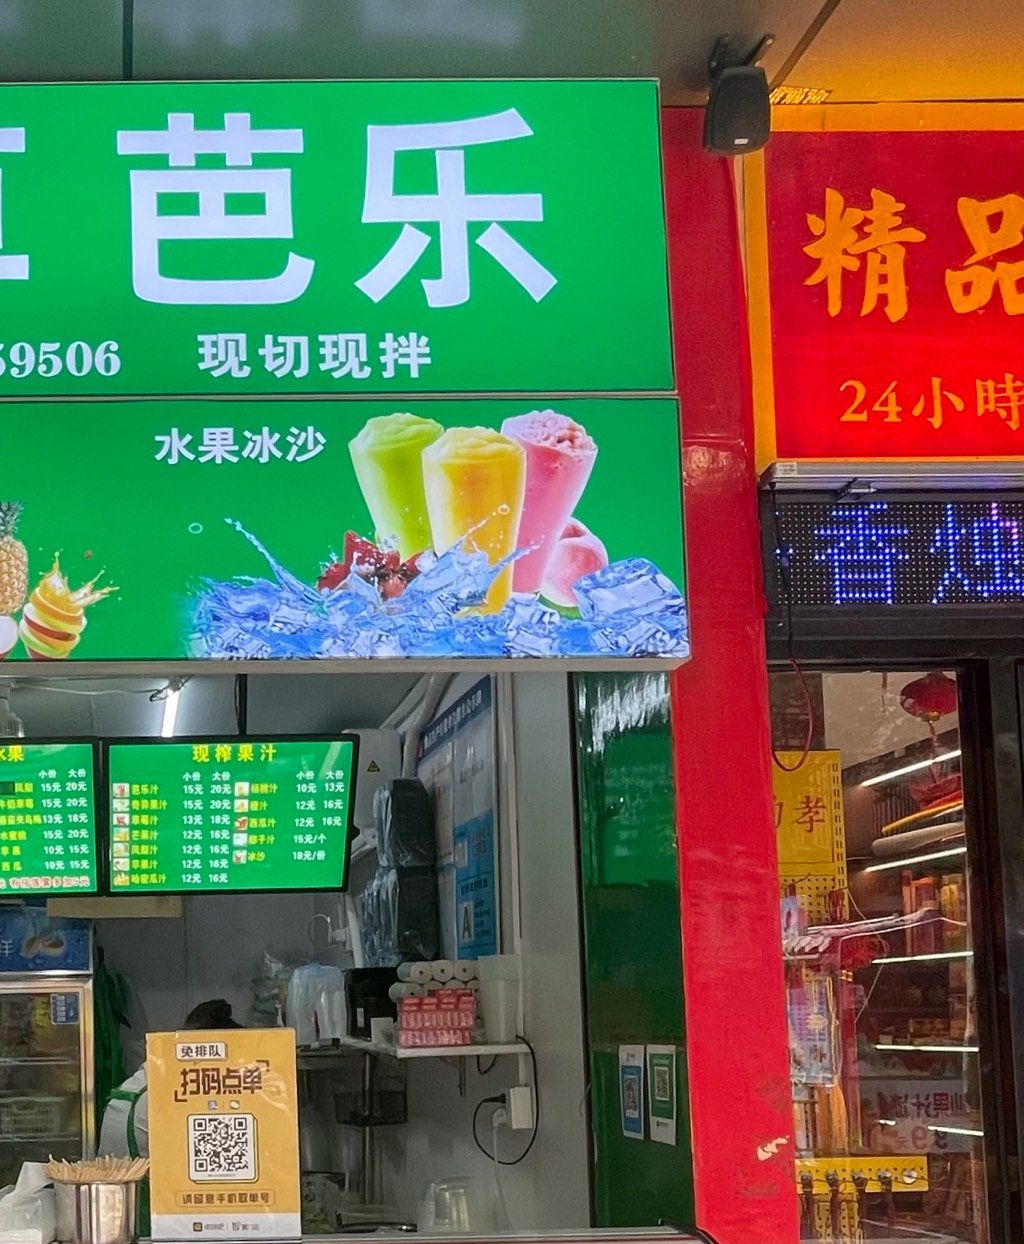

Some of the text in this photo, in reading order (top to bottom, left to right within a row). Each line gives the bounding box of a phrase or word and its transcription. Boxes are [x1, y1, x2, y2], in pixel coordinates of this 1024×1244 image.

[803, 188, 1024, 322] 精品
[198, 332, 431, 378] 现切现拌
[155, 426, 326, 464] 水果冰沙
[193, 744, 277, 762] 现榨果汁
[39, 768, 86, 779] 小份 大份
[183, 771, 230, 782] 小份 大份
[296, 770, 344, 780] 小份 大份
[41, 782, 61, 793] 15元
[66, 781, 87, 792] 20元
[183, 784, 204, 795] 15元
[210, 784, 231, 795] 20元
[296, 782, 345, 793] 10元 13元
[42, 799, 62, 809] 15元
[67, 798, 87, 808] 20元
[183, 799, 204, 810] 15元
[210, 799, 231, 810] 20元
[296, 800, 316, 811] 12元
[323, 799, 344, 810] 16元
[43, 814, 63, 825] 13元
[68, 813, 88, 824] 18元
[182, 814, 203, 825] 13元
[210, 814, 231, 825] 18元
[295, 817, 315, 828] 12元
[322, 816, 342, 826] 16元
[44, 830, 63, 840] 15元
[68, 829, 89, 839] 20元
[183, 829, 203, 840] 12元
[209, 829, 231, 840] 16元
[293, 833, 327, 845] 15元/个
[44, 844, 89, 855] 10元 15元
[182, 844, 203, 855] 12元
[209, 844, 230, 855] 16元
[293, 850, 326, 861] 18元/份
[45, 860, 65, 871] 10元
[70, 859, 90, 870] 15元
[182, 859, 203, 869] 12元
[209, 858, 229, 869] 16元
[182, 873, 202, 884] 12元
[208, 873, 229, 884] 16元
[181, 1045, 222, 1058] 免排队
[181, 1066, 263, 1097] 扫码点单
